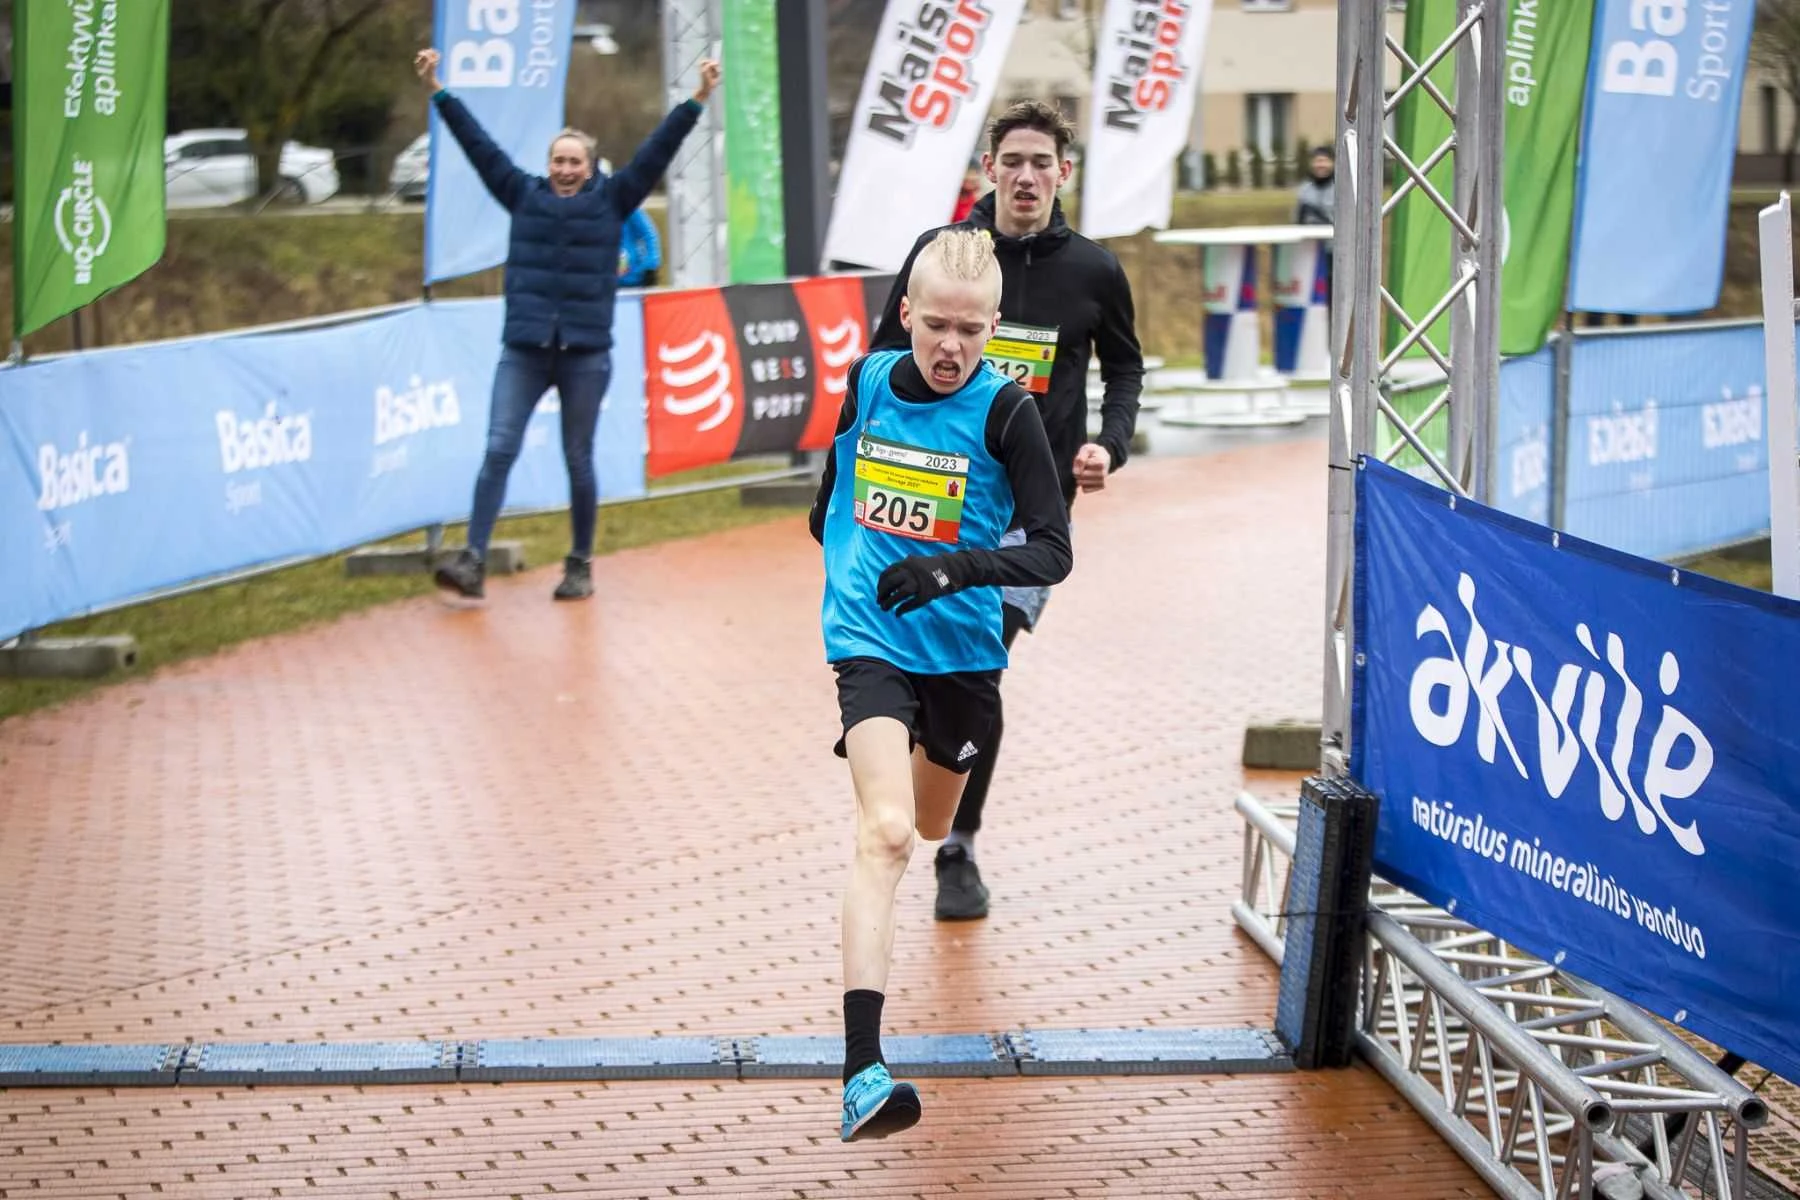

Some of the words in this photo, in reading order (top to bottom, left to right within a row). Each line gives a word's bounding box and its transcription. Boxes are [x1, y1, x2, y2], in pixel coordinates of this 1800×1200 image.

[91, 0, 122, 116] aplinka
[448, 0, 519, 88] Ba
[1105, 0, 1159, 131] Mais
[1603, 0, 1688, 96] Ba
[72, 160, 94, 284] BIO-CIRCLE
[215, 401, 313, 473] Basica
[374, 374, 460, 446] Basica
[38, 430, 130, 510] Basica
[925, 455, 957, 471] 2023
[869, 492, 930, 532] 205
[1409, 572, 1713, 855] akvilė
[1412, 796, 1508, 863] natūralus
[1510, 837, 1631, 919] mineralinis
[1631, 895, 1706, 960] vanduo
